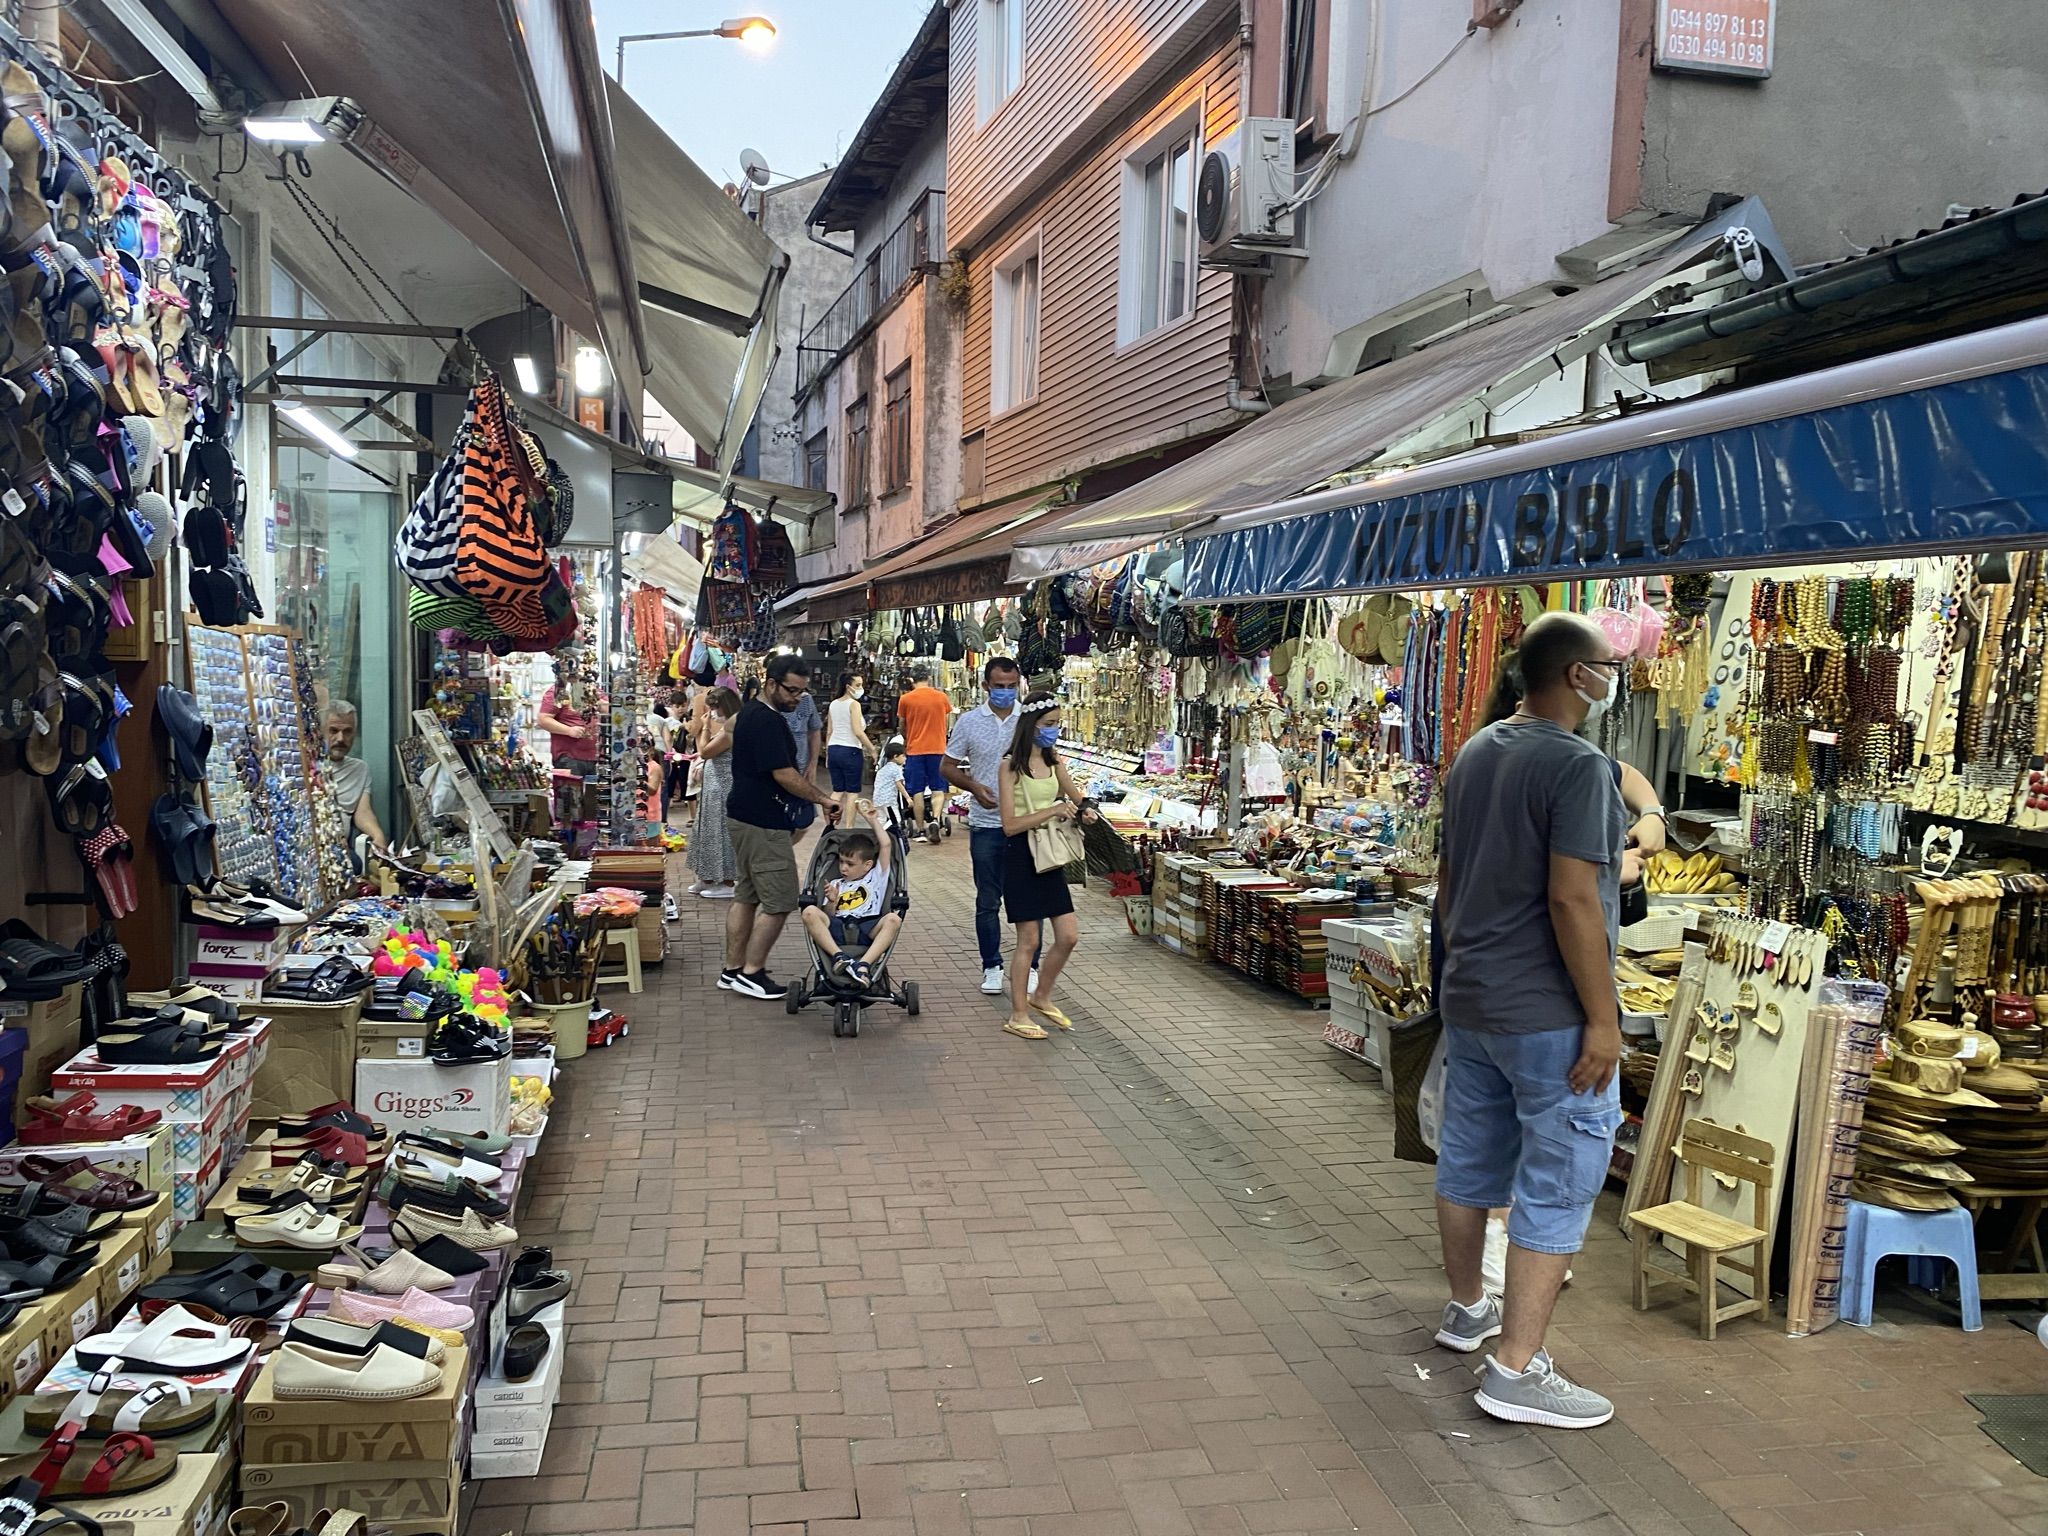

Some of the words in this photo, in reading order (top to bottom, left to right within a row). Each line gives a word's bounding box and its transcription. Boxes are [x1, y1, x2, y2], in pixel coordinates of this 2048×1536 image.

[1670, 8, 1700, 29] 0544
[1704, 13, 1728, 33] 897
[1731, 16, 1746, 36] 81
[1750, 18, 1765, 39] 13
[1669, 34, 1700, 56] 0530
[1703, 39, 1726, 58] 494
[1730, 42, 1745, 61] 10
[1748, 44, 1764, 63] 98
[203, 941, 245, 958] forex
[374, 1091, 444, 1118] Giggs
